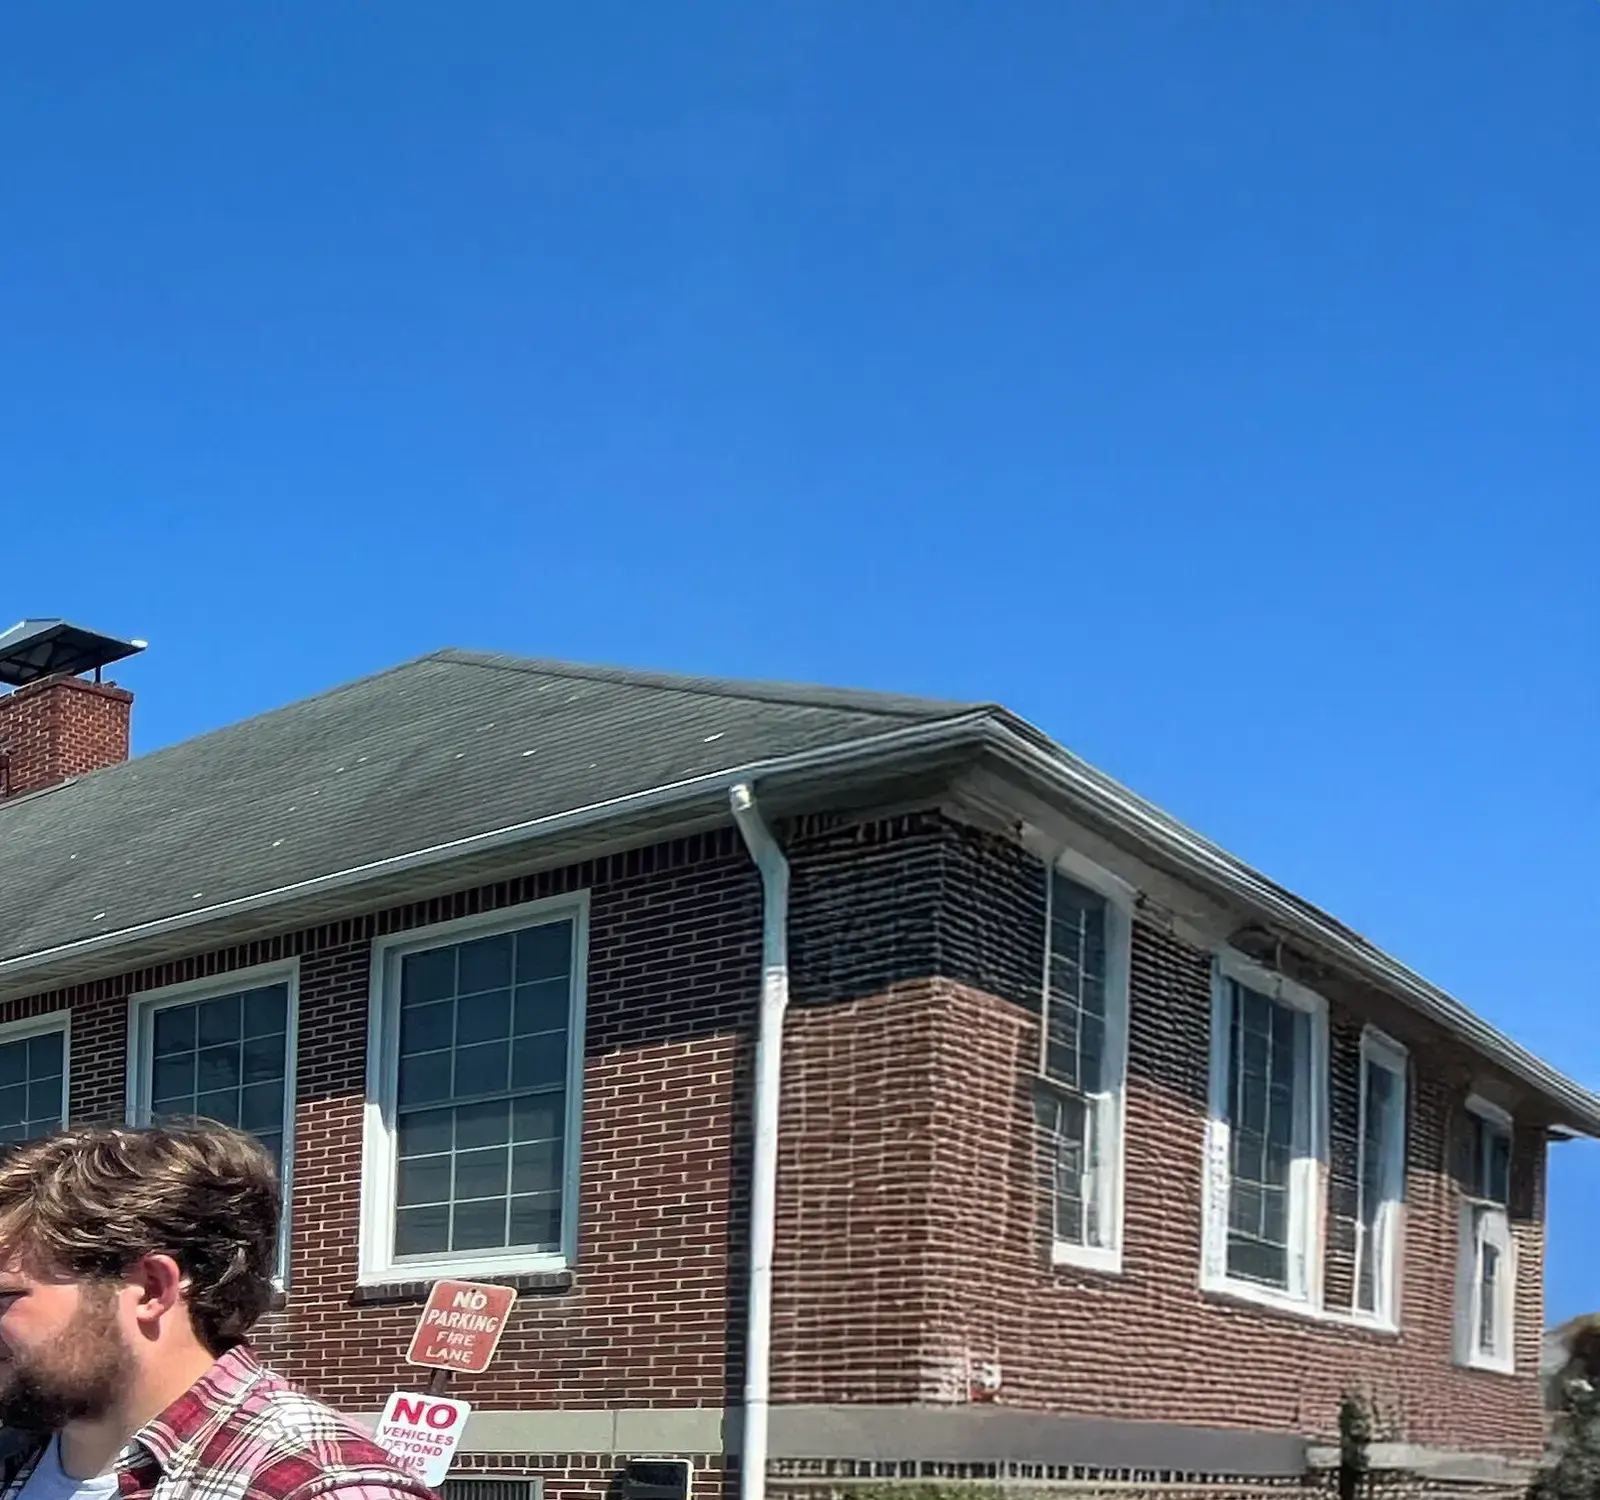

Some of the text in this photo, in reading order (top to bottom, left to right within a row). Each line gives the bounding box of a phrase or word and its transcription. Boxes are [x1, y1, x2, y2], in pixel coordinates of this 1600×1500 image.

[452, 1290, 488, 1311] NO
[426, 1309, 500, 1333] PARKING
[436, 1330, 478, 1347] FIRE
[425, 1346, 474, 1364] LANE
[390, 1398, 458, 1430] NO
[383, 1425, 455, 1446] VEHICLES
